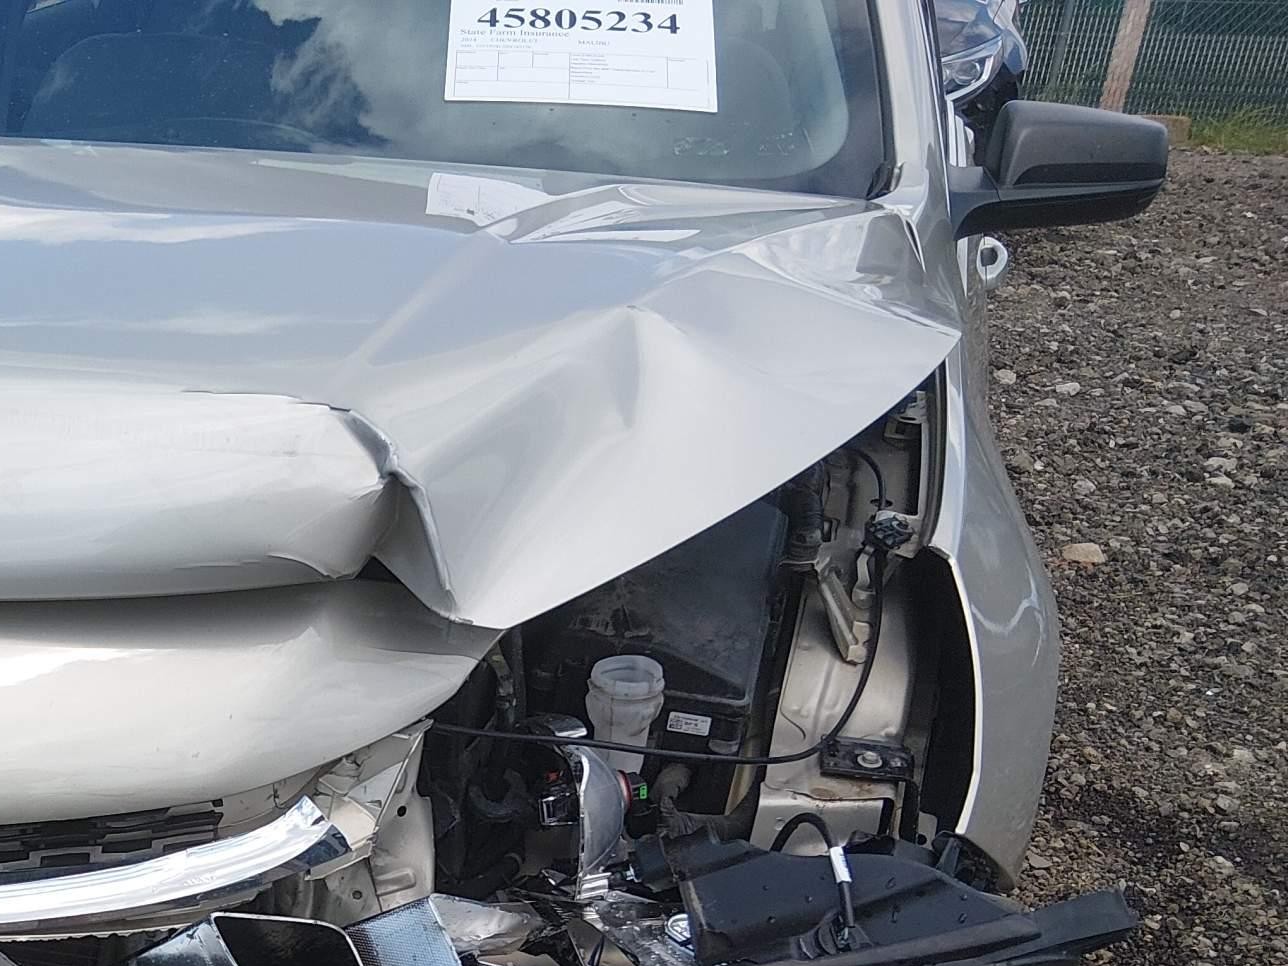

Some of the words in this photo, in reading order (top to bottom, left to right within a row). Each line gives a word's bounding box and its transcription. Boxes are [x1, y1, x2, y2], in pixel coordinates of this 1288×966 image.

[477, 7, 680, 34] 45805234
[460, 28, 486, 36] State
[519, 29, 570, 38] Insurance
